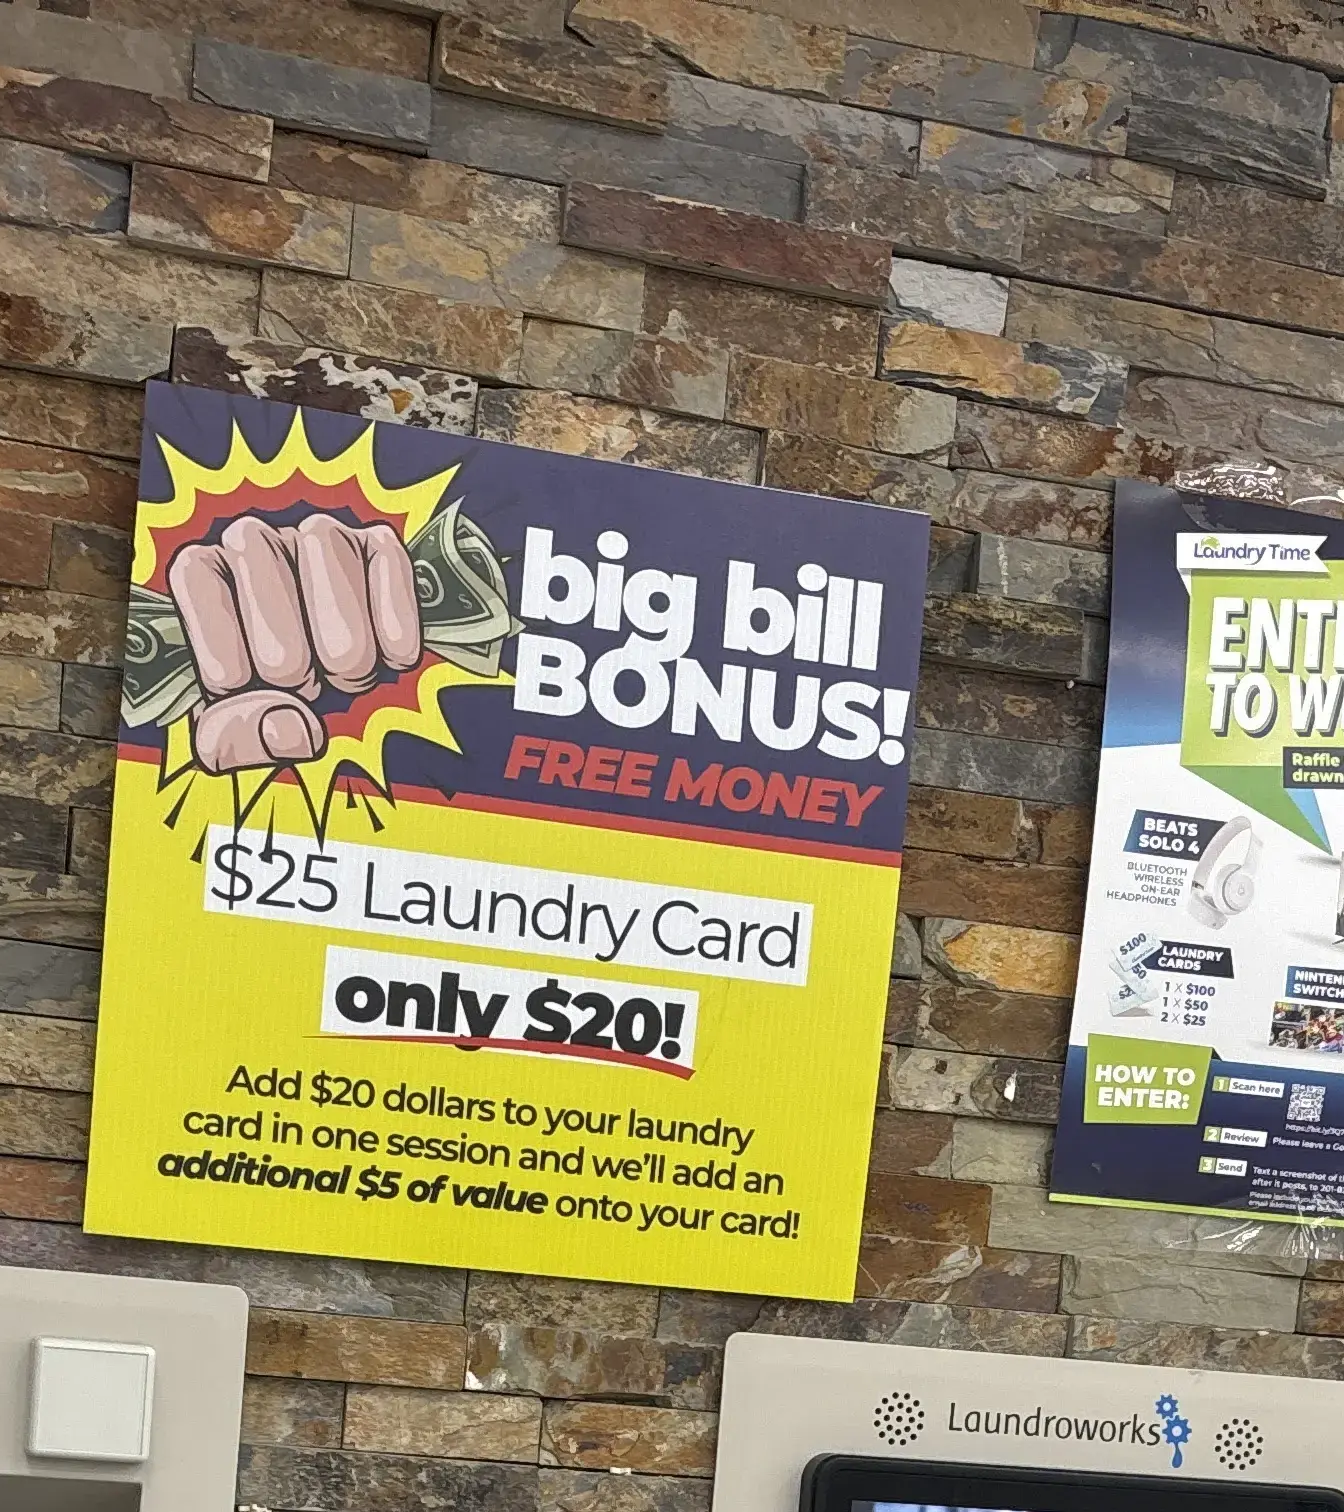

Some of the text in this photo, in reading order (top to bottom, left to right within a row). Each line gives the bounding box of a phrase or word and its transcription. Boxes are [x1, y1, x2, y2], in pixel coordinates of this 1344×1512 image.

[1193, 543, 1311, 565] Laundry Time
[521, 525, 883, 671] big bill
[513, 634, 911, 767] BONUS!
[1206, 673, 1277, 738] TO
[503, 735, 883, 826] FREE MONEY
[210, 840, 800, 968] $25 Laundry Card
[334, 972, 685, 1059] only $20!
[226, 1065, 755, 1153] Add $20 dollars to your laundry
[1095, 1065, 1196, 1086] HOW TO
[1098, 1088, 1190, 1110] ENTER:
[183, 1107, 262, 1142] card
[273, 1116, 301, 1145] in
[312, 1124, 378, 1153] one
[387, 1129, 510, 1168] session
[518, 1138, 583, 1175] and
[672, 1154, 736, 1190] add
[744, 1168, 784, 1194] an
[157, 1149, 800, 1240] additional $5 of value onto your card!
[948, 1402, 1162, 1447] Laundroworks
